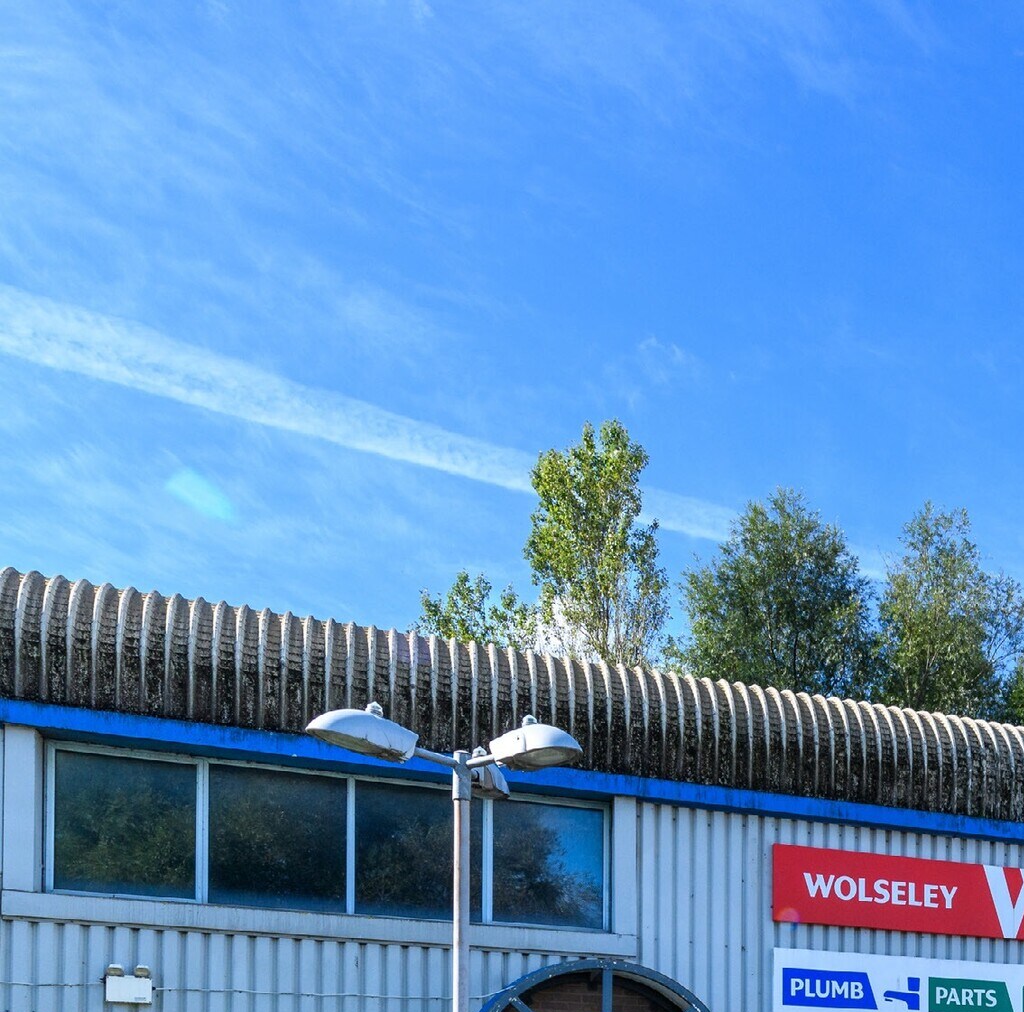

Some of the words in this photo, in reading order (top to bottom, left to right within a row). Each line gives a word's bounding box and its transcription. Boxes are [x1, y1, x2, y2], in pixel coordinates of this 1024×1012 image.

[803, 871, 958, 909] WOLSELEY
[789, 977, 864, 1000] PLUMB
[935, 986, 997, 1008] PARTS
